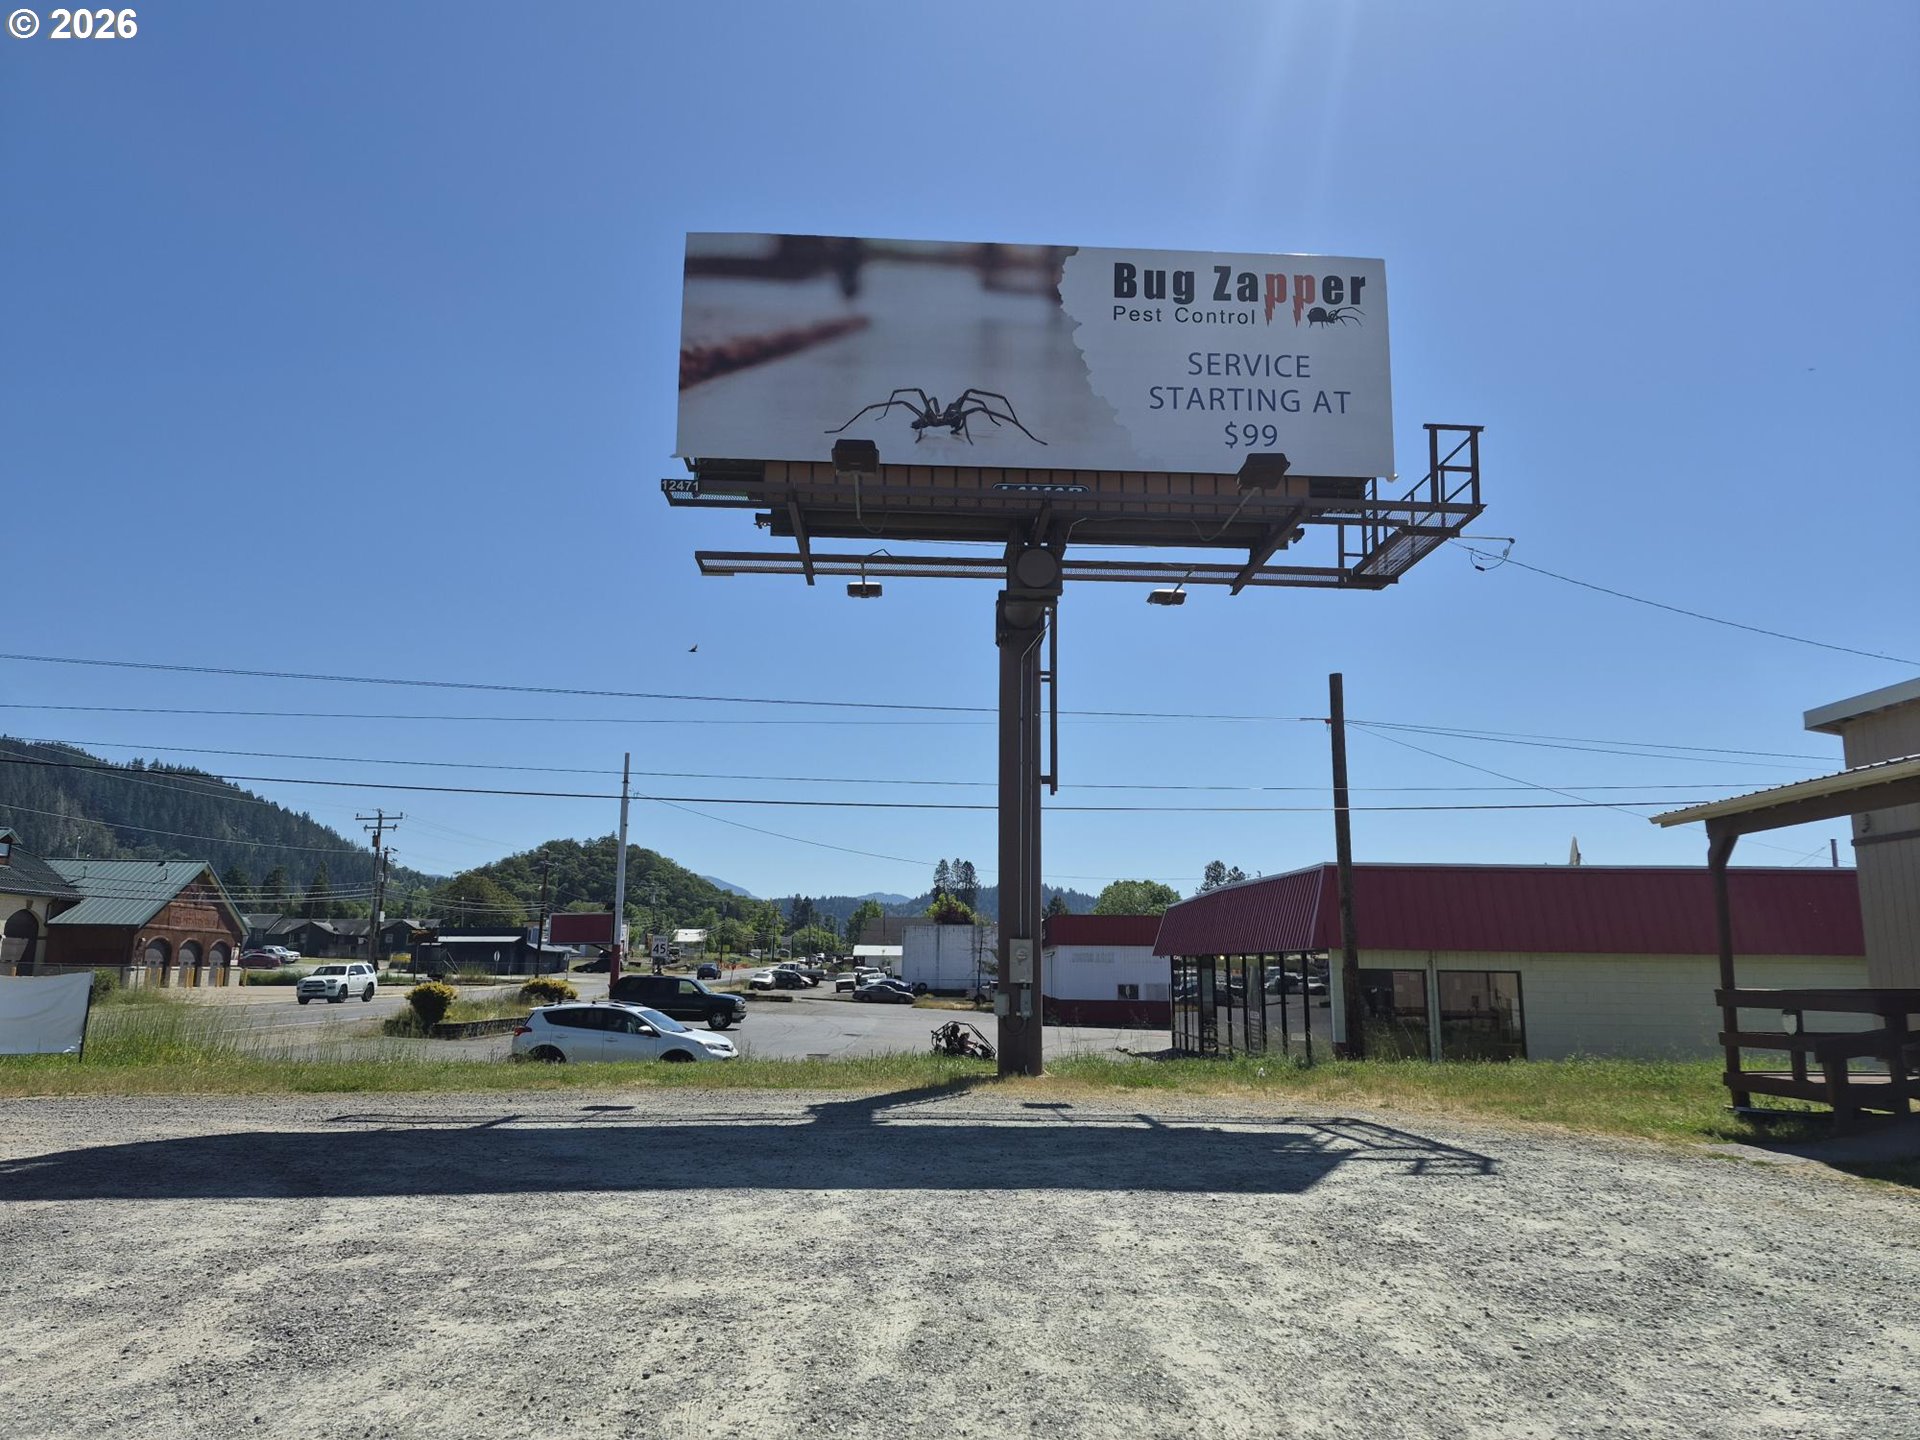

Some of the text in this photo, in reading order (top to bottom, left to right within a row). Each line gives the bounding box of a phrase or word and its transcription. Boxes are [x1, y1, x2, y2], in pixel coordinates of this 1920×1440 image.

[1113, 262, 1367, 328] Bug Zapper
[1113, 305, 1256, 325] Pest Control
[1188, 352, 1311, 378] SERVICE
[1149, 386, 1352, 414] STARTING AT
[1224, 421, 1278, 449] $99
[662, 480, 699, 492] 12471
[653, 943, 666, 954] 45
